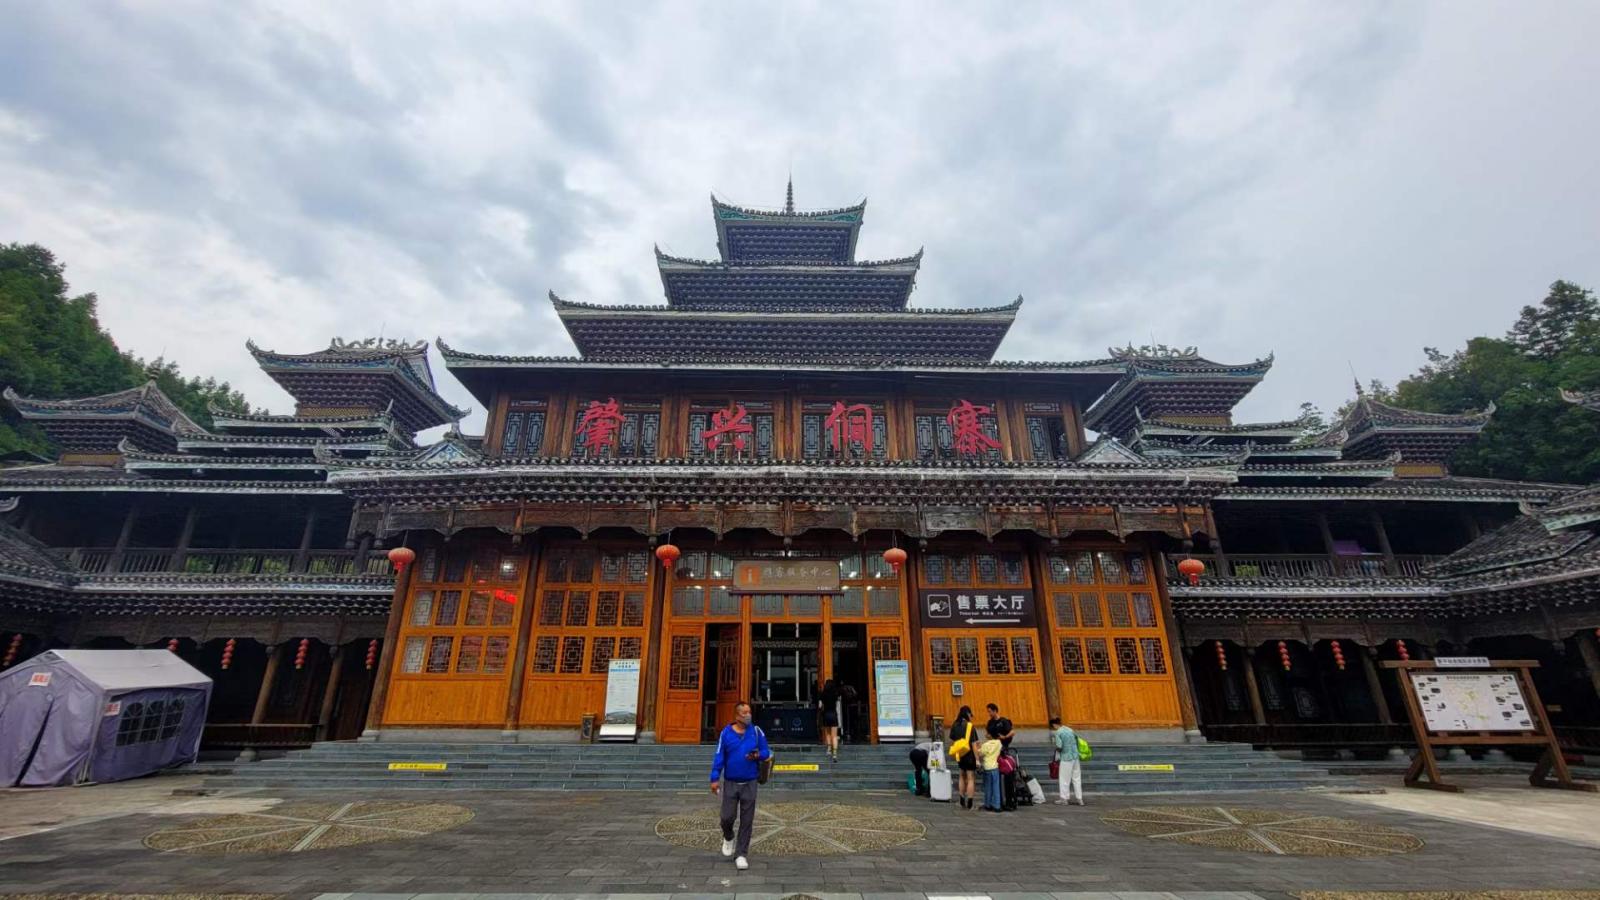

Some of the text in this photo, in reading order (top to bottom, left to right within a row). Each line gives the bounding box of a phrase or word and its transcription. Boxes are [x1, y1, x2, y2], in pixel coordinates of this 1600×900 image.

[575, 397, 1002, 454] 肇兴侗寨
[956, 595, 1025, 610] 售票大厅
